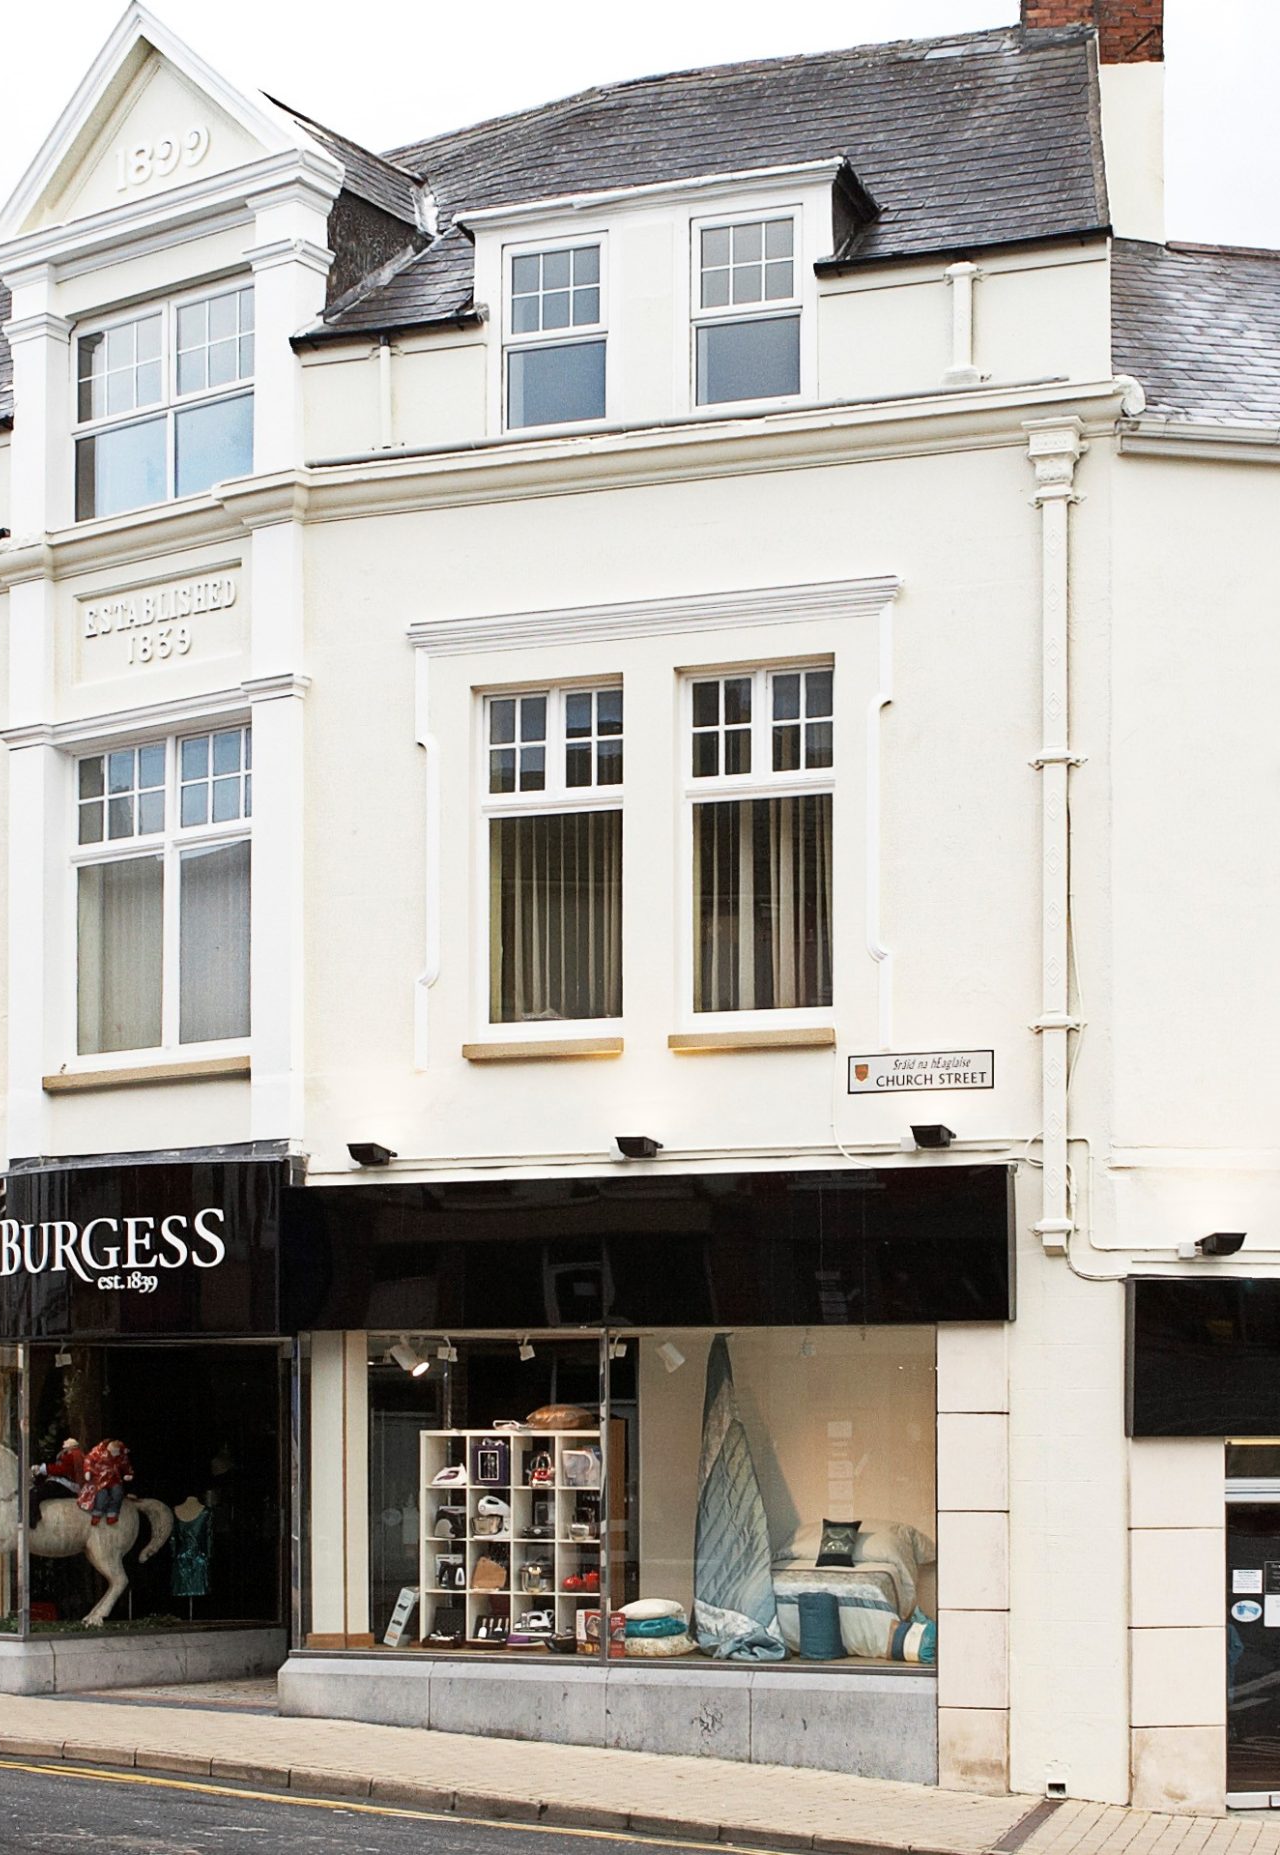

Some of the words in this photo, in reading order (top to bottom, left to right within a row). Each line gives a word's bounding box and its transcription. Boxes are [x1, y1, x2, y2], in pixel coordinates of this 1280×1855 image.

[116, 122, 211, 192] 1899
[85, 577, 236, 638] ESTABLISHED
[876, 1074, 933, 1087] CHURCH
[939, 1071, 987, 1085] STREET
[918, 1060, 928, 1070] na
[931, 1056, 972, 1070] hEaglaise
[0, 1207, 226, 1283] BURGESS
